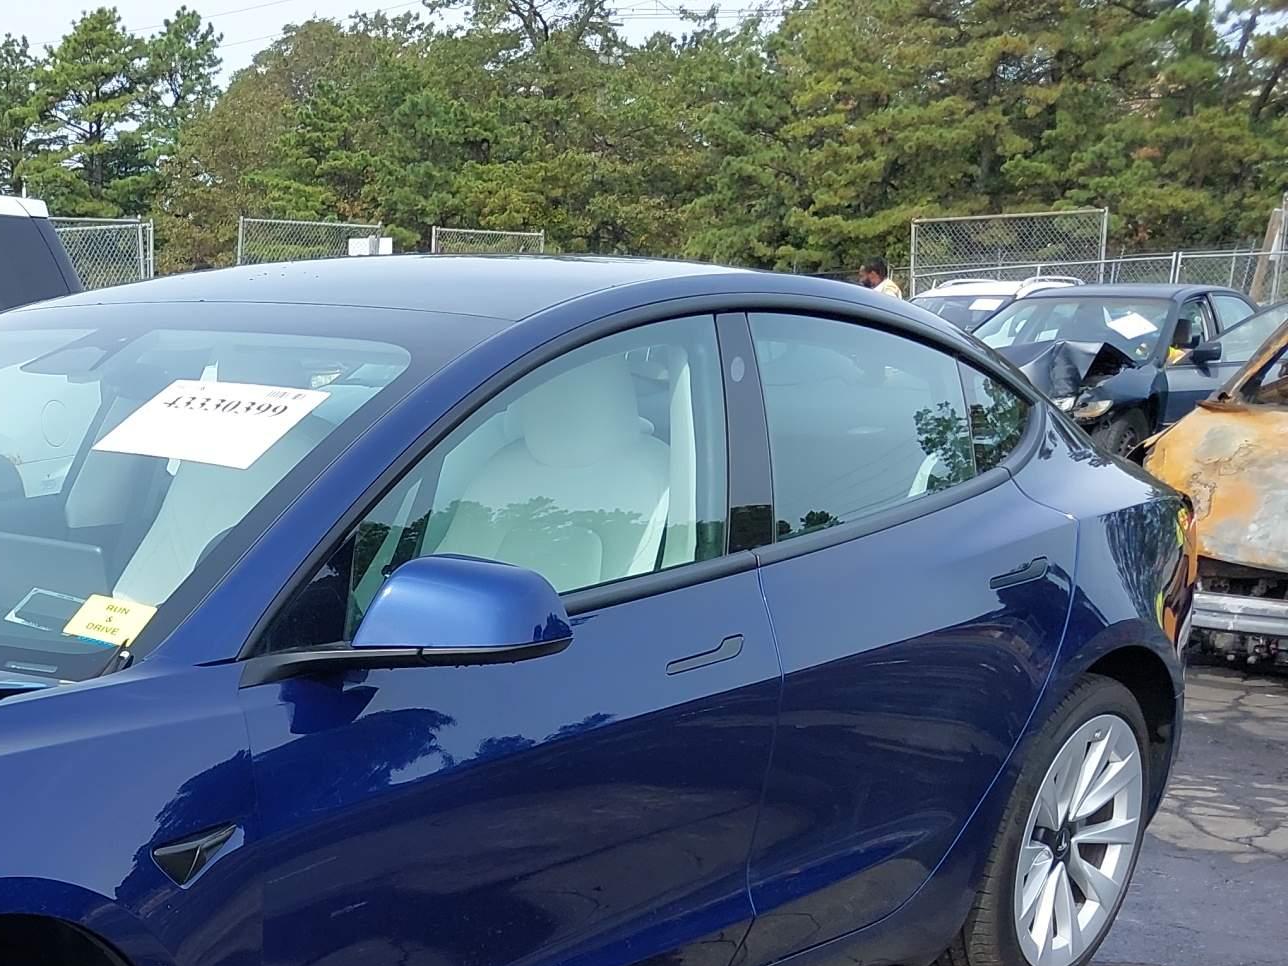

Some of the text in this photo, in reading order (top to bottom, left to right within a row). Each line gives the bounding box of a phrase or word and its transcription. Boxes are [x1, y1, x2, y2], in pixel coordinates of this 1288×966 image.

[163, 395, 289, 417] 43330399
[105, 604, 130, 615] RUN
[85, 622, 120, 635] DRIVE
